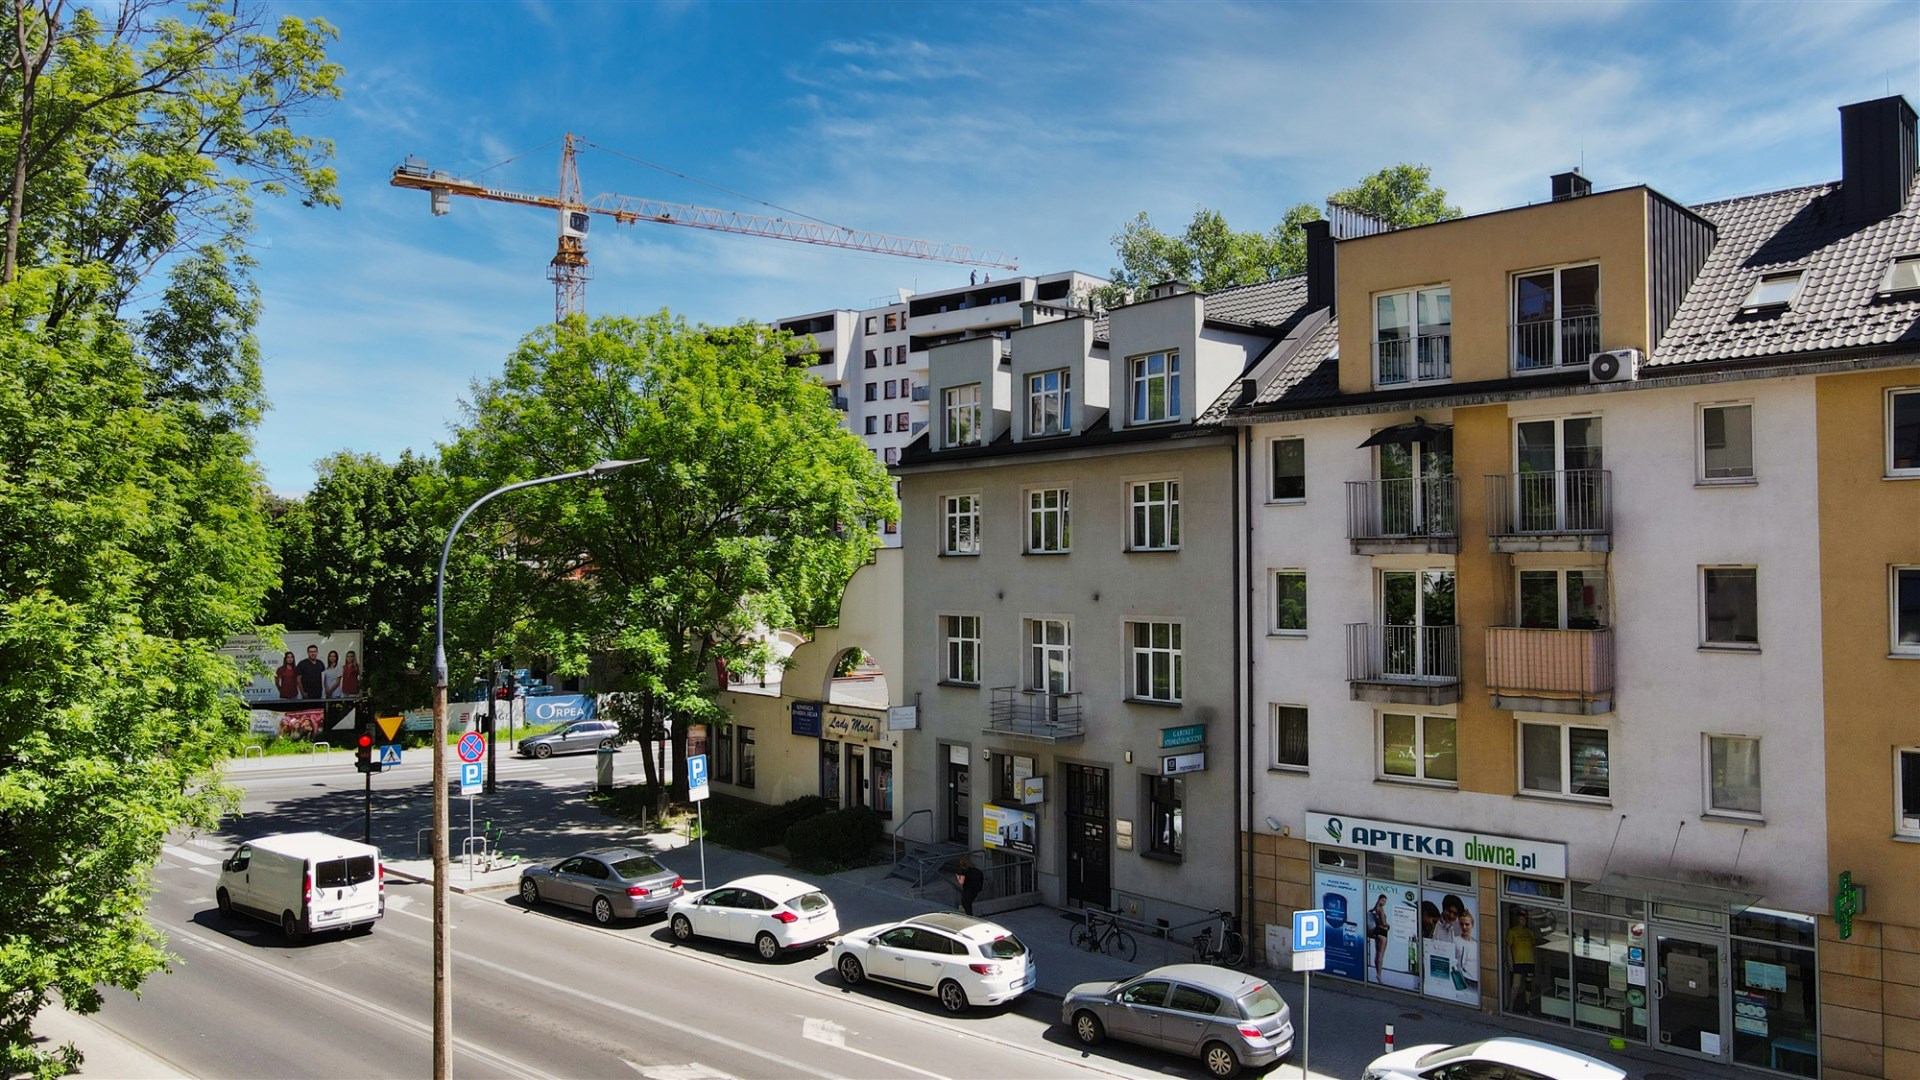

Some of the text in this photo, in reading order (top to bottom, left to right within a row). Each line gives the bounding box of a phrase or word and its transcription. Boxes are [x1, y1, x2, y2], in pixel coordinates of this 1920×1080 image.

[536, 699, 585, 719] ORPEA
[828, 716, 849, 733] Lady
[851, 718, 875, 733] Moda
[465, 765, 479, 785] P
[692, 758, 704, 779] P
[1352, 827, 1536, 870] APTEKA oliwna.pl
[1368, 883, 1399, 894] ELANCYL
[1301, 915, 1319, 947] P
